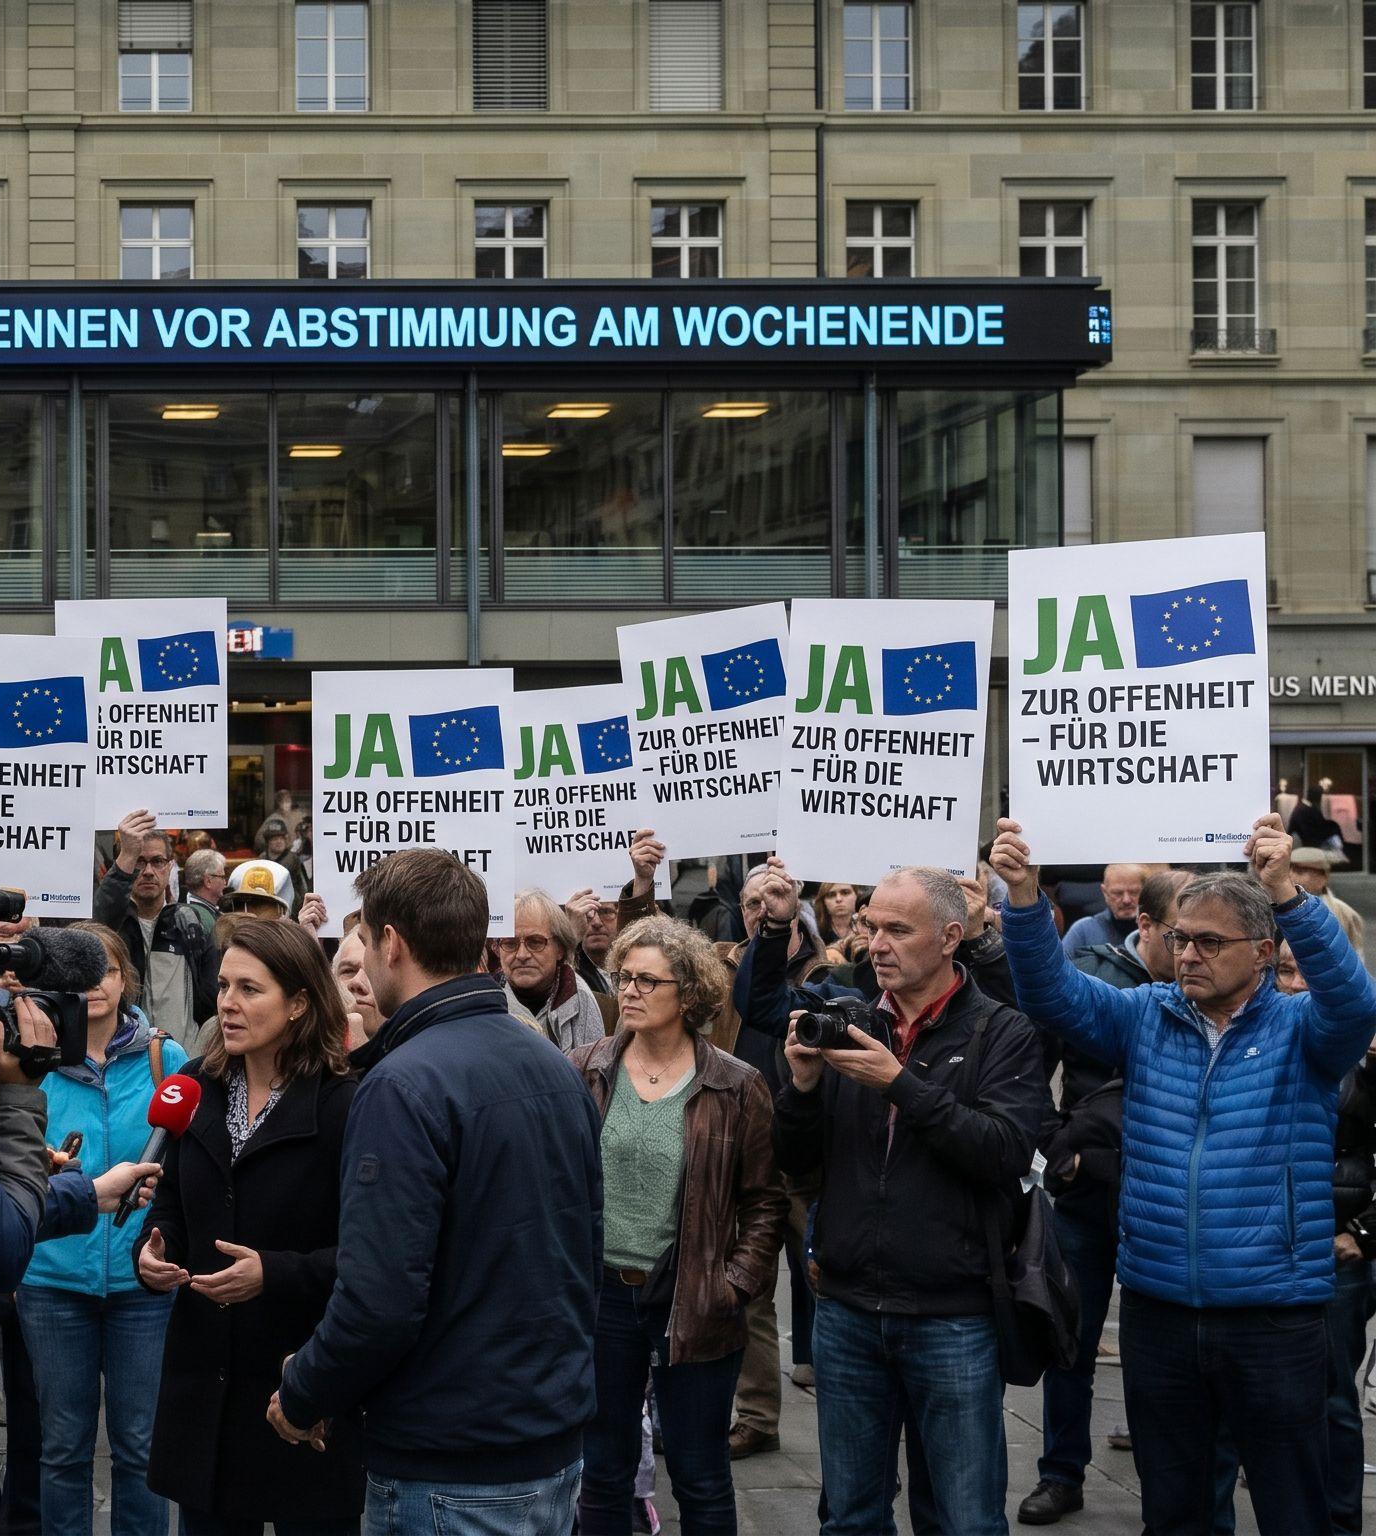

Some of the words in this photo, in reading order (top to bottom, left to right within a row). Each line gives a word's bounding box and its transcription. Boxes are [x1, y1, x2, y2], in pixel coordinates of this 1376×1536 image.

[152, 307, 253, 348] VOR
[262, 307, 576, 348] ABSTIMMUNG
[589, 307, 658, 346] AM
[673, 305, 1004, 346] WOCHENENDE
[1023, 594, 1123, 675] JA
[100, 638, 133, 691] A
[795, 644, 872, 715] JA
[636, 656, 702, 721] JA
[1022, 689, 1078, 715] ZUR
[1089, 681, 1254, 713] OFFENHEIT
[110, 704, 218, 723] OFFENHEIT
[97, 726, 123, 749] ÜR
[130, 730, 162, 748] DIE
[324, 713, 402, 780] JA
[638, 729, 676, 751] ZUR
[792, 726, 836, 750] ZUR
[845, 728, 974, 757] OFFENHEIT
[1050, 717, 1107, 750] FÜR
[1119, 721, 1166, 748] DIE
[97, 755, 207, 774] IRTSCHAFT
[514, 724, 575, 780] JA
[659, 750, 698, 776] FÜR
[704, 749, 737, 771] DIE
[813, 755, 858, 783] FÜR
[865, 761, 902, 786] DIE
[1037, 754, 1237, 786] WIRTSCHAFT
[323, 791, 367, 813] ZUR
[377, 791, 504, 813] OFFENHEIT
[514, 788, 549, 807] ZUR
[556, 782, 636, 804] OFFENHE
[801, 789, 957, 821] WIRTSCHAFT
[345, 816, 390, 843] FÜR
[399, 821, 435, 842] DIE
[533, 807, 569, 830] FÜR
[575, 808, 605, 827] DIE
[526, 830, 637, 854] WIRTSCHAF
